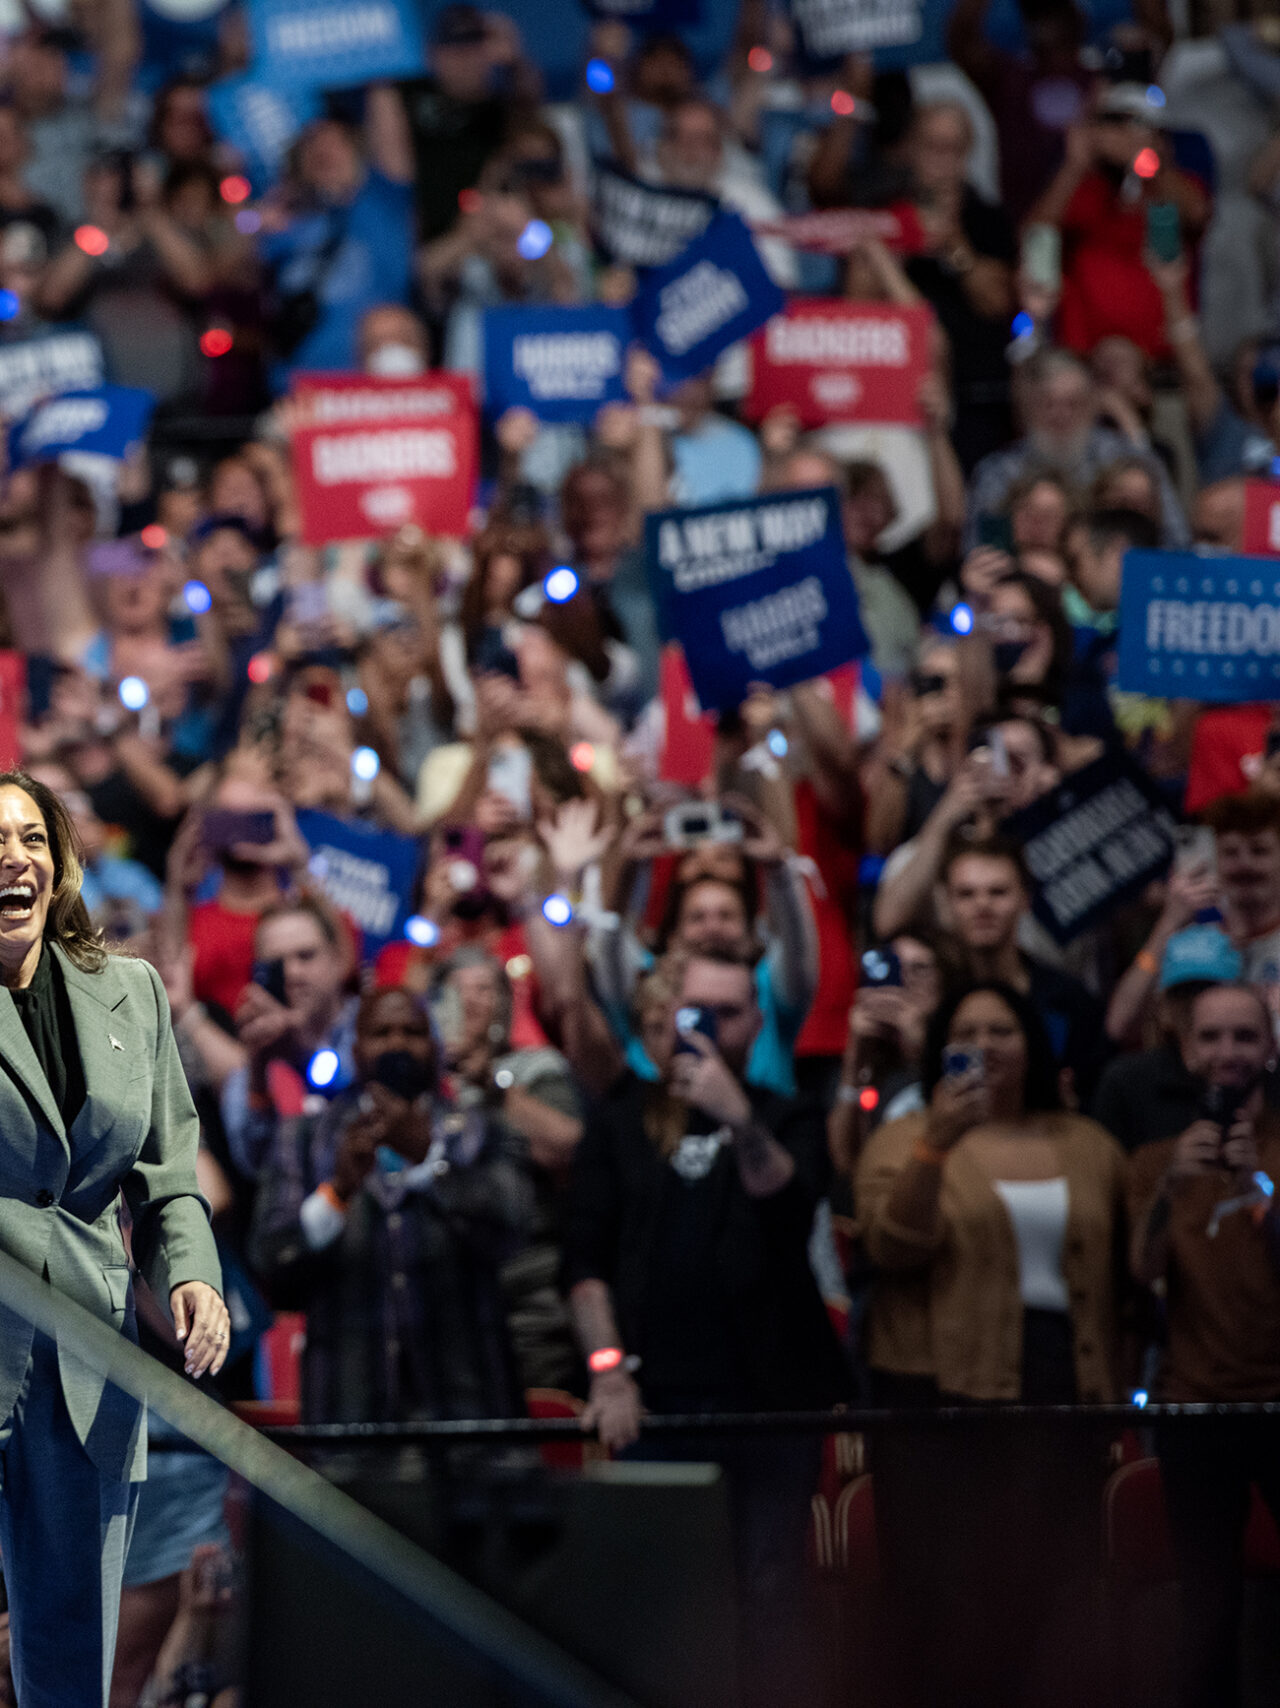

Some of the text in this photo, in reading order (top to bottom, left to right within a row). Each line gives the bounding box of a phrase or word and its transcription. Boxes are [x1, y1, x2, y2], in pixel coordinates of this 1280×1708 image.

[657, 518, 685, 571] A
[682, 506, 761, 558] NEW
[757, 496, 830, 553] WAY
[1146, 599, 1280, 657] FREEDO
